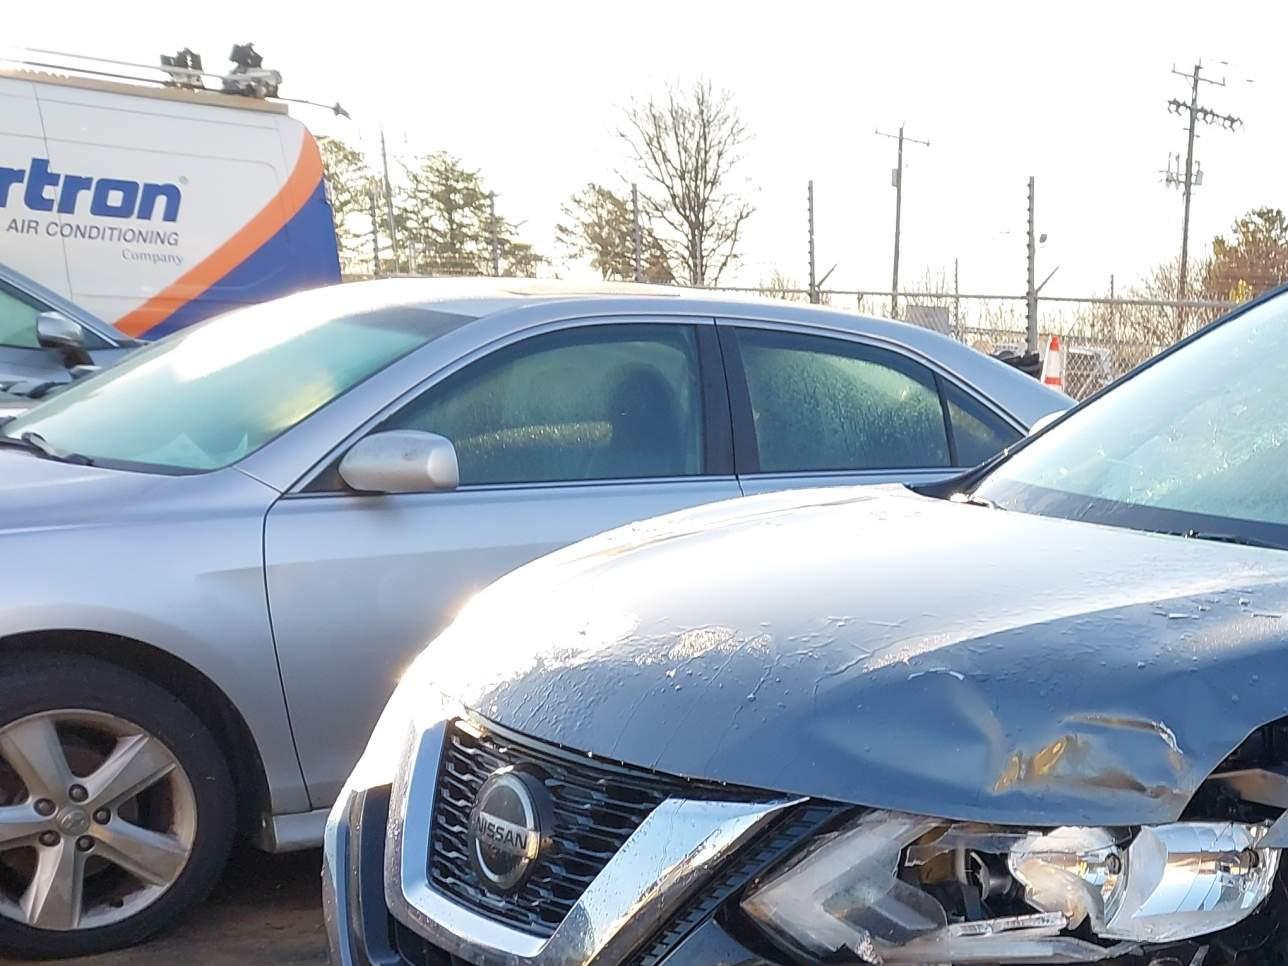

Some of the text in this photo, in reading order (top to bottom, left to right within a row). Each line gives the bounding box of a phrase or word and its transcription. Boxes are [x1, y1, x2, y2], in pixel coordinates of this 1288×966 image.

[6, 218, 179, 246] AIR CONDITIONING
[121, 249, 183, 265] Company
[476, 814, 528, 850] NISSAN
